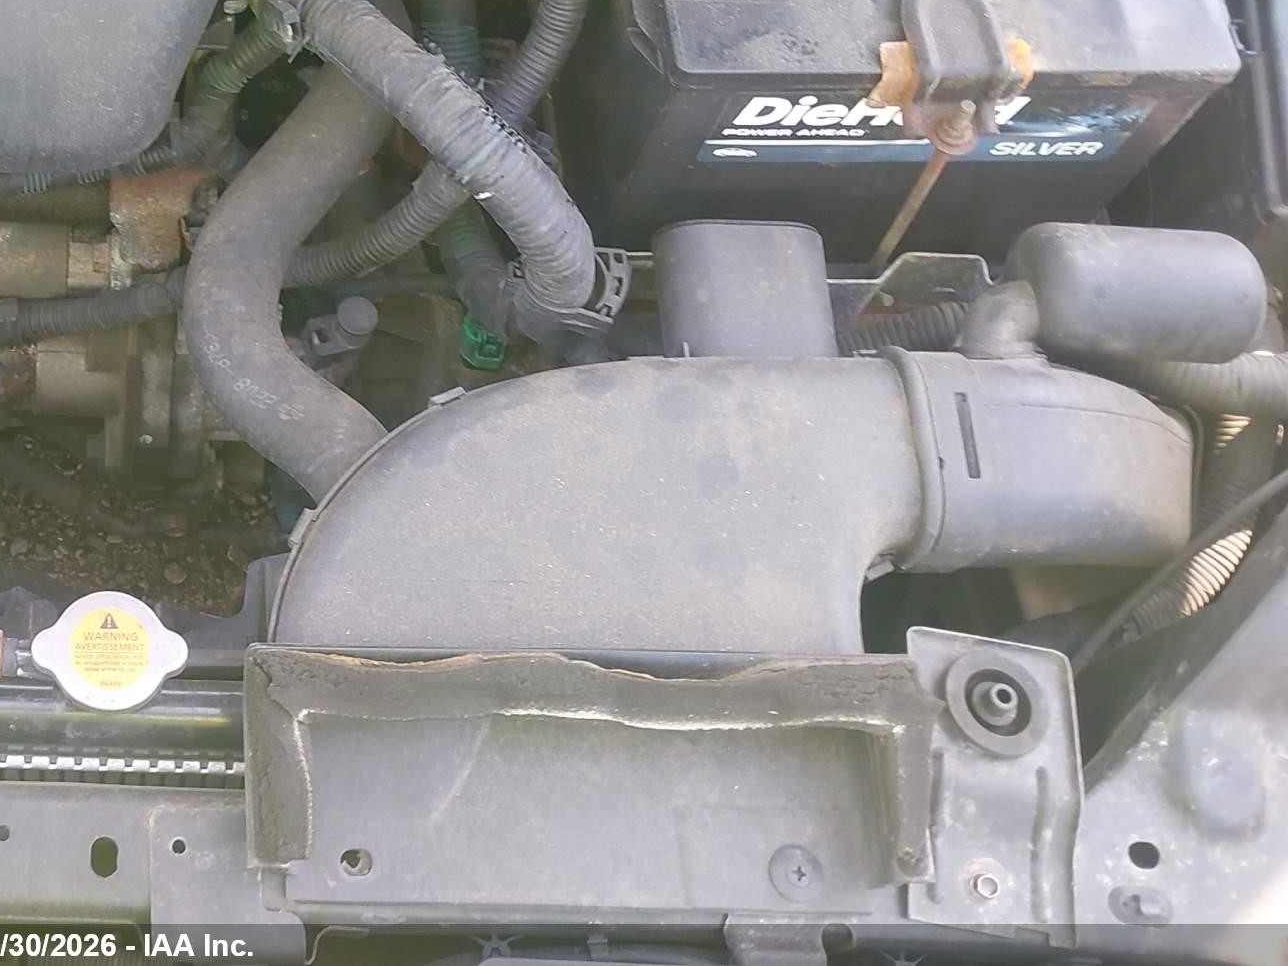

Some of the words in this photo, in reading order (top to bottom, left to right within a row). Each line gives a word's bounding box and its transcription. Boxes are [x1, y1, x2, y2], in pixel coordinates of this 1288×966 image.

[721, 128, 793, 137] POWER
[795, 128, 866, 137] AHEAD
[988, 140, 1104, 157] SILVER
[82, 632, 139, 642] WARNING
[74, 643, 145, 651] AVERTISSEMENT
